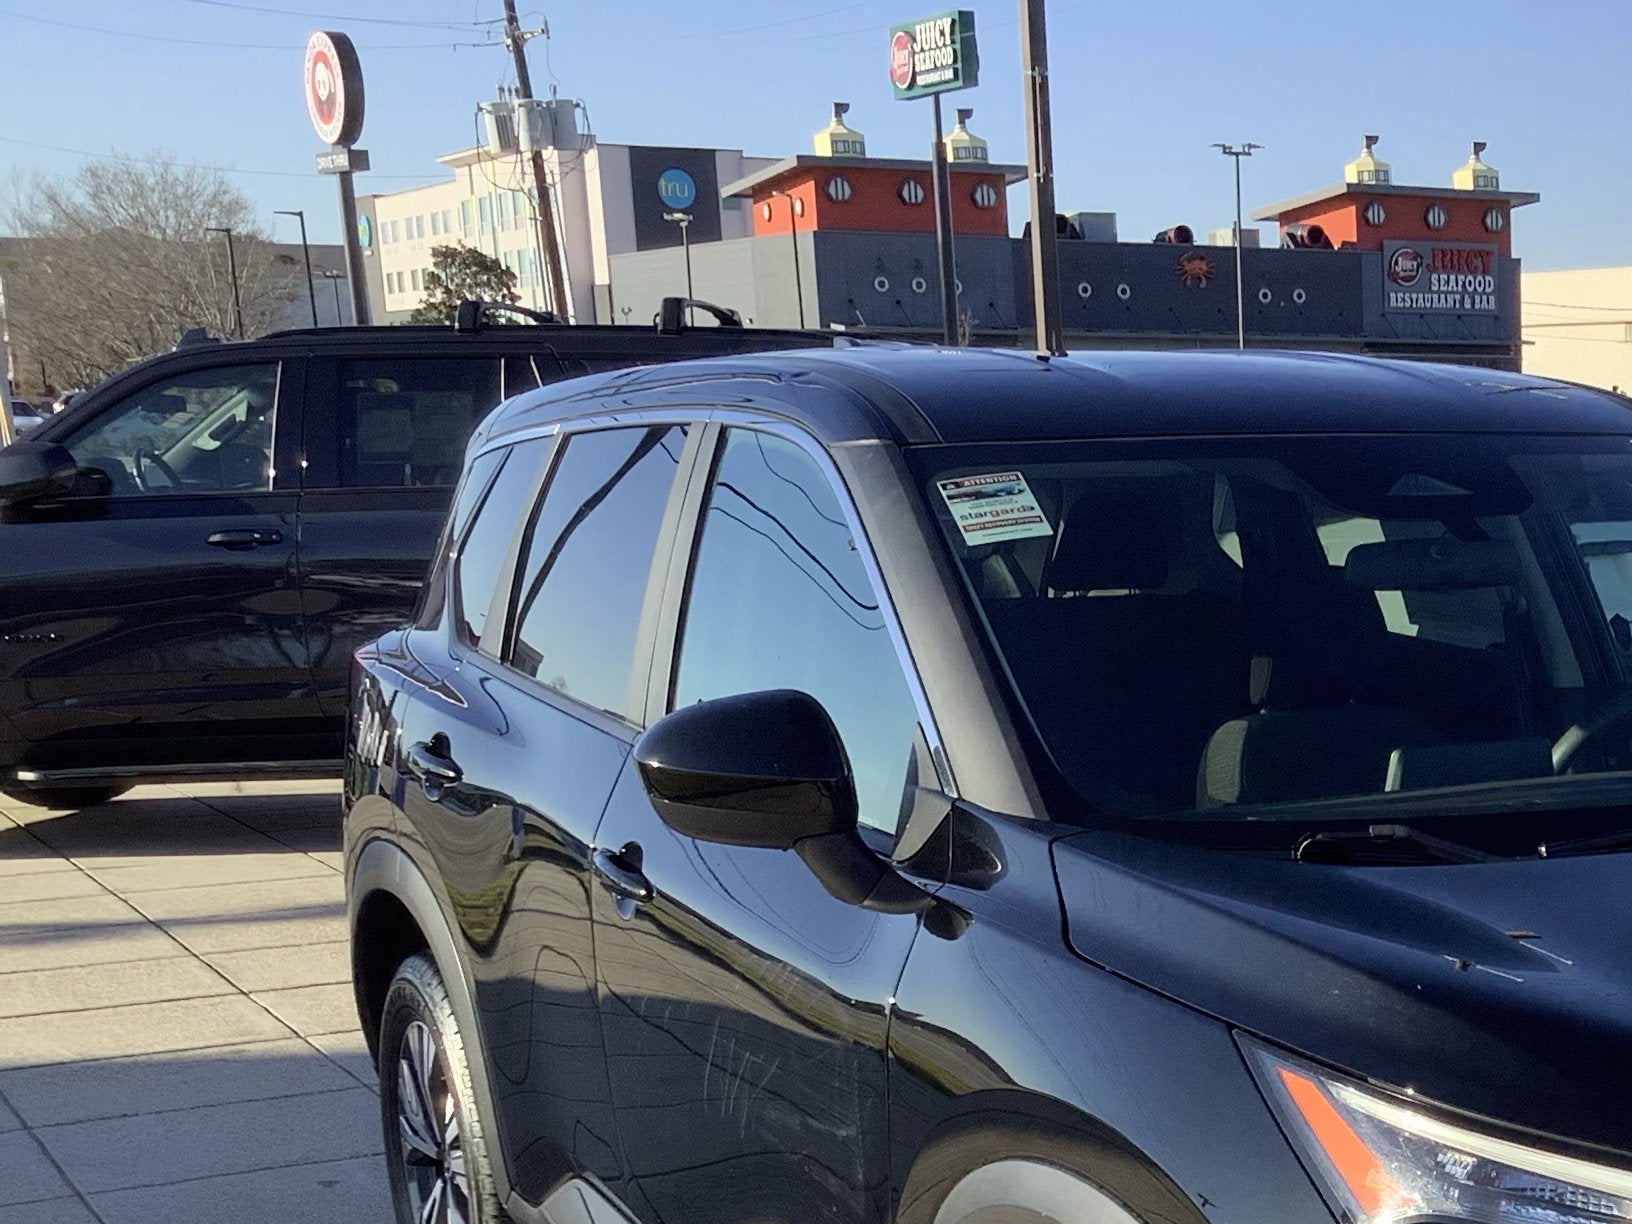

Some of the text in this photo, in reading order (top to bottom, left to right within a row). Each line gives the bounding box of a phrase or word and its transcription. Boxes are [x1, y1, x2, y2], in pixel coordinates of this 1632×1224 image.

[913, 17, 951, 52] JUICY
[914, 45, 954, 73] SEAFOOD
[658, 177, 689, 198] tru
[1425, 247, 1494, 274] JUICY
[1430, 273, 1494, 293] SEAFOOD
[1389, 292, 1496, 310] RESTAURANT & BAR
[963, 474, 1018, 487] ATTENTION
